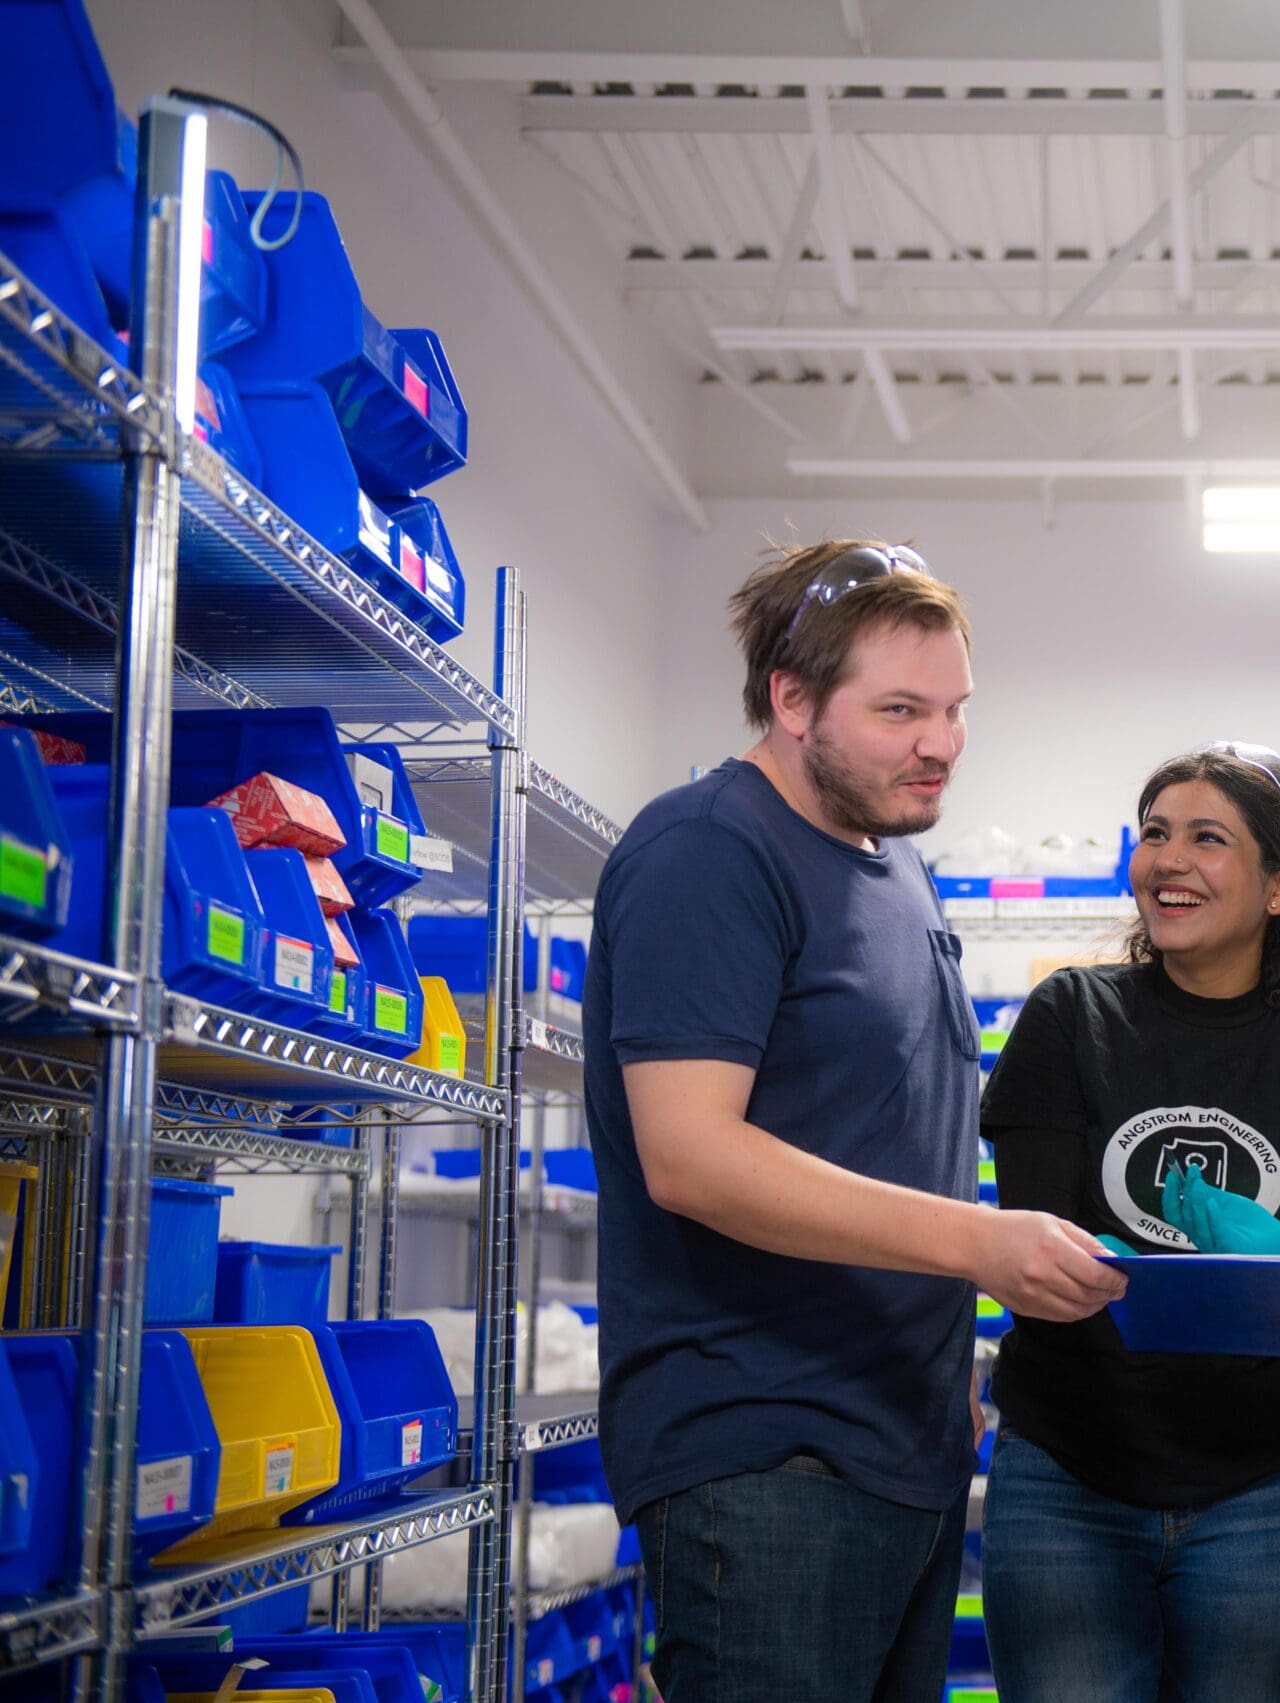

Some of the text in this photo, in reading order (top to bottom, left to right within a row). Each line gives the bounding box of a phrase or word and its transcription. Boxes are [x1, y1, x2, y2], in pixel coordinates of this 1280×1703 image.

[1118, 1113, 1277, 1174] ANGSTROM ENGINEERING
[1138, 1219, 1180, 1242] SINCE
